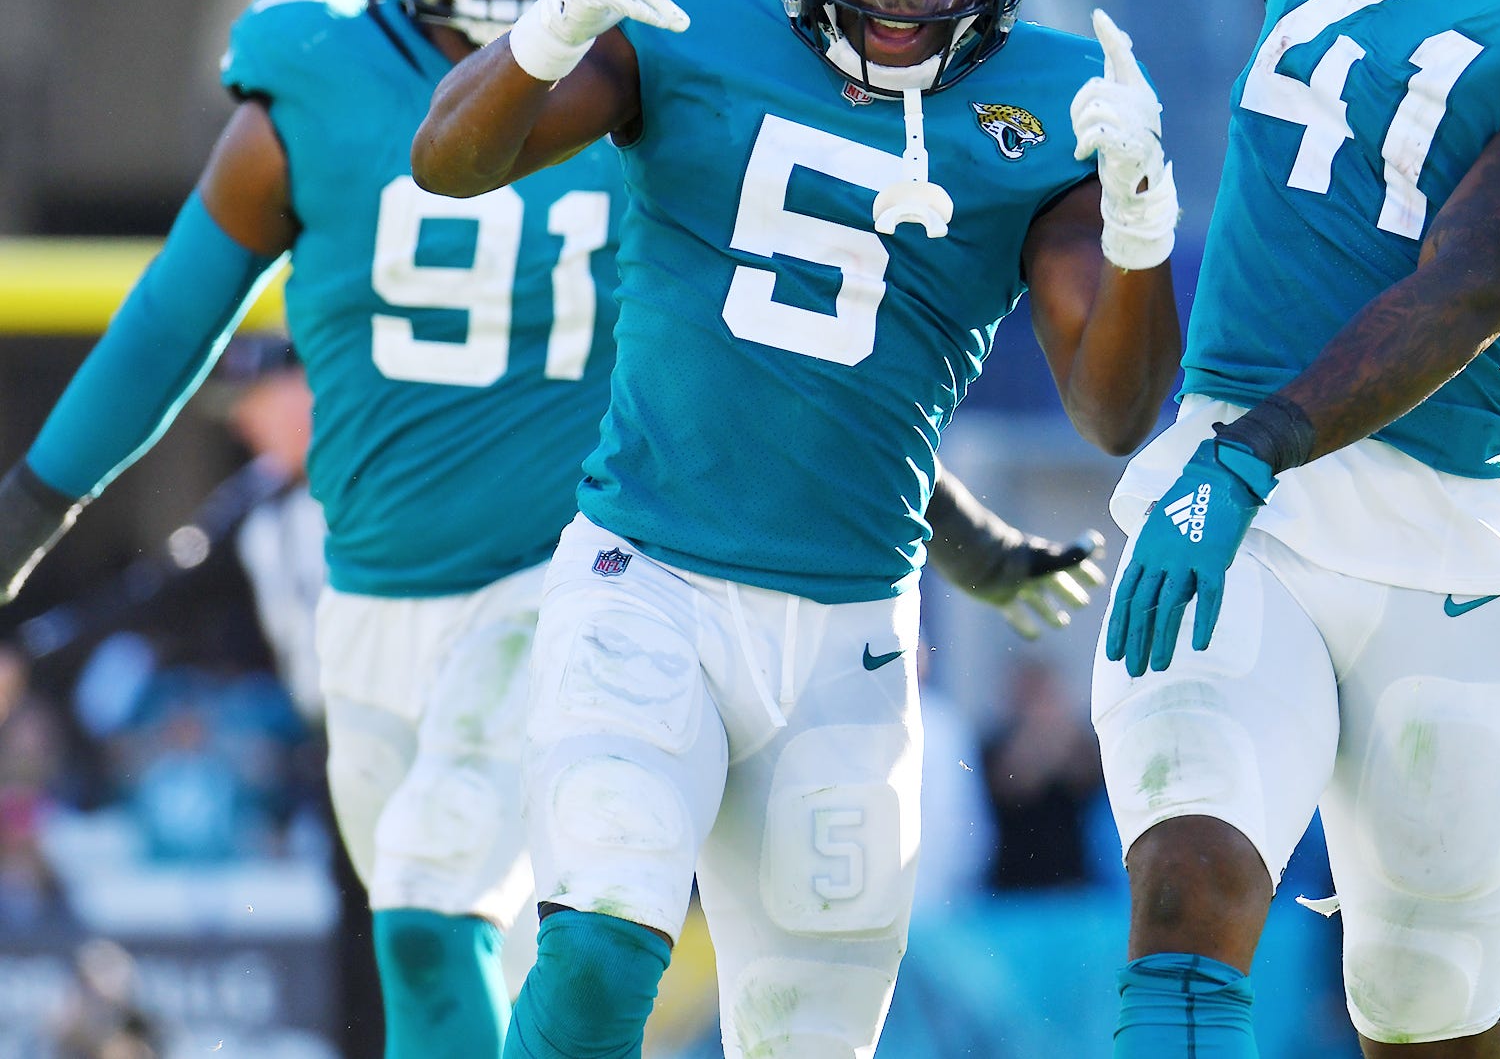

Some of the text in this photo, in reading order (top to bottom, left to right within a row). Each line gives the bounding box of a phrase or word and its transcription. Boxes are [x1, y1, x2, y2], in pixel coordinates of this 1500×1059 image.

[846, 84, 870, 101] NFL
[722, 112, 904, 367] 5
[371, 174, 610, 387] 91
[1189, 483, 1212, 543] adidas
[597, 560, 620, 572] NFL
[811, 808, 865, 900] 5
